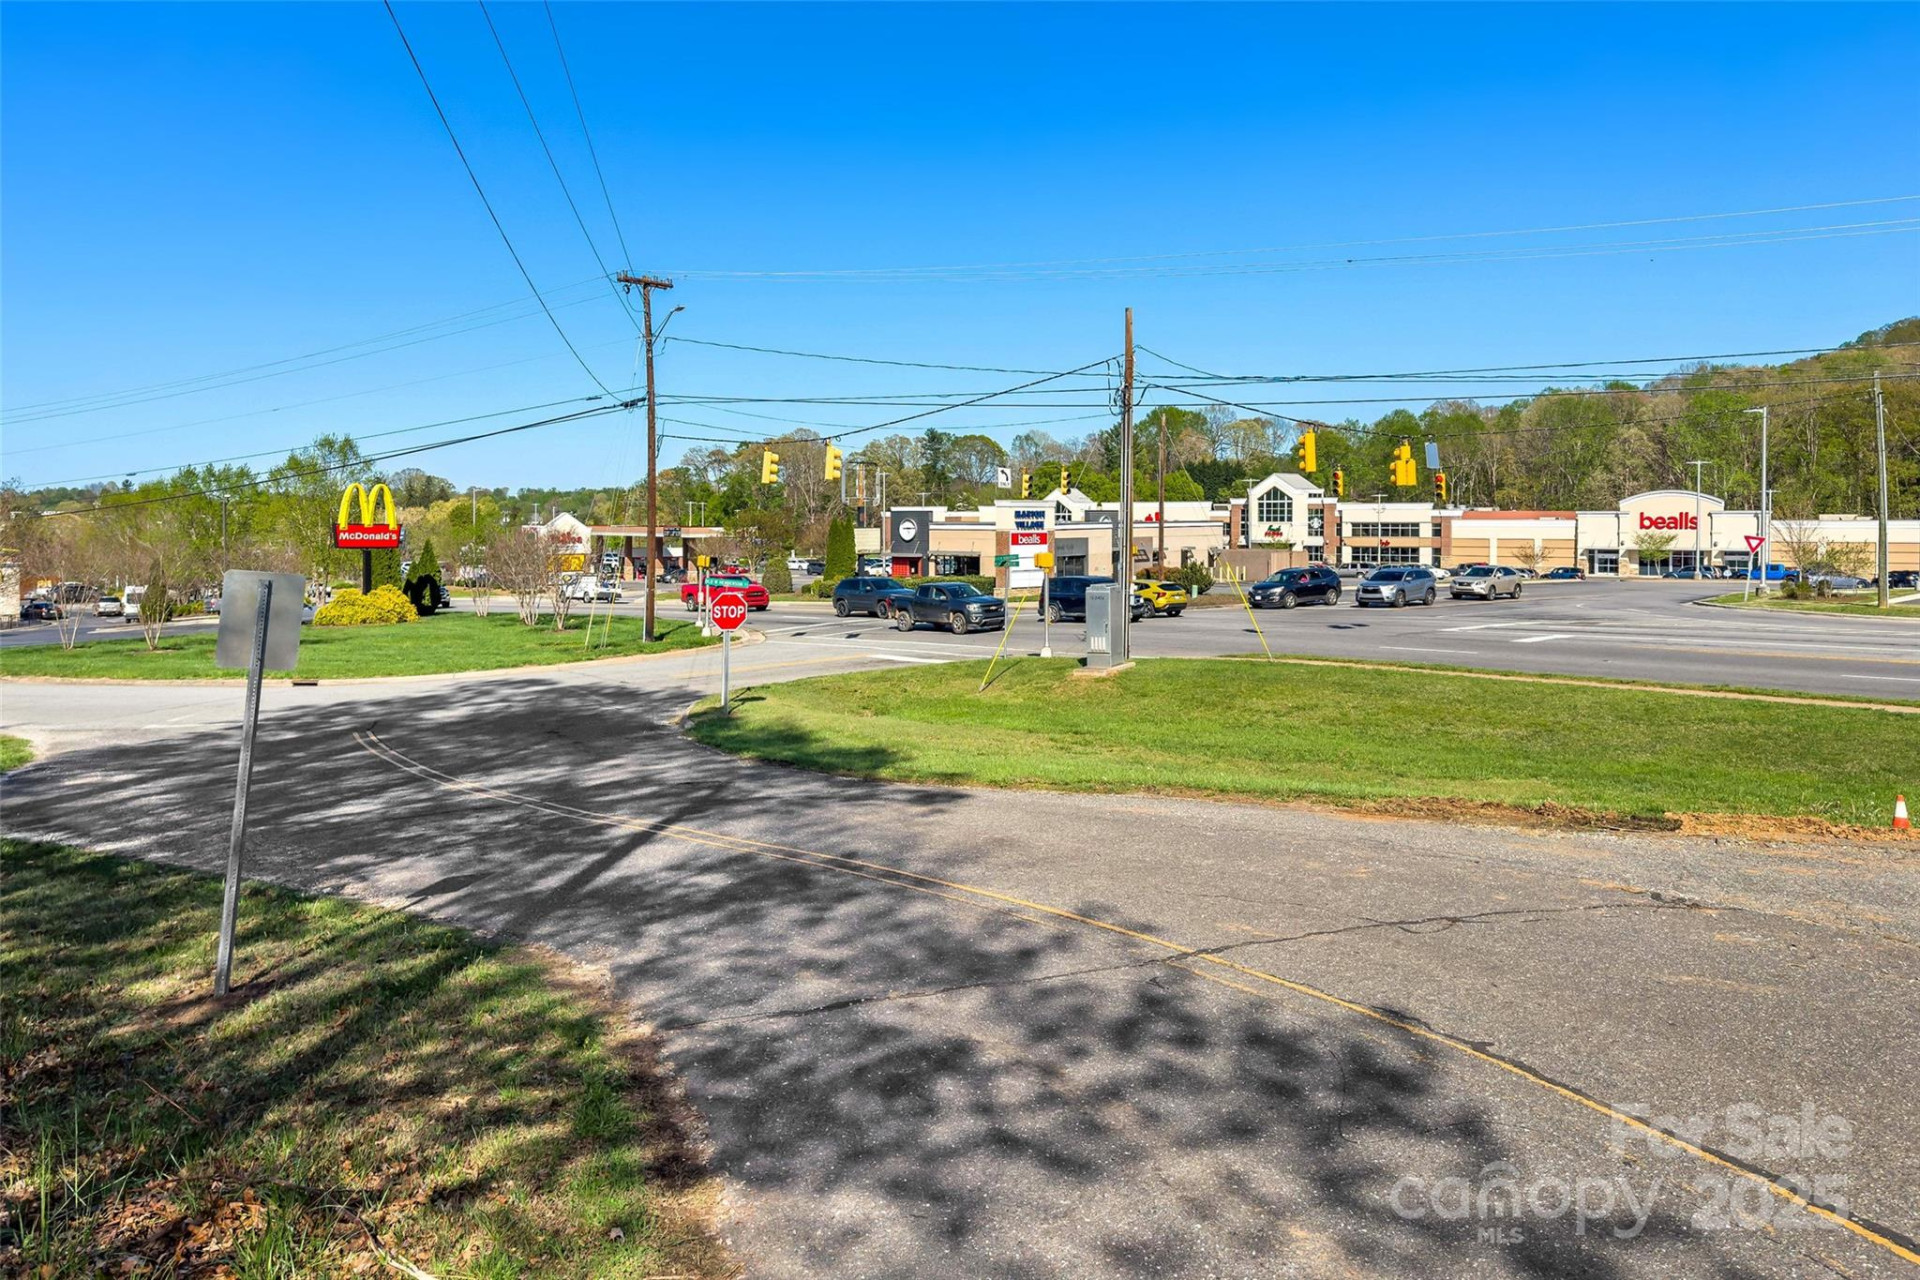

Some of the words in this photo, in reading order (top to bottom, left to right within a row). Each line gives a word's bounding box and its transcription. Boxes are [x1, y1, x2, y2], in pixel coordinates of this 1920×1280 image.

[1639, 511, 1698, 530] bealls
[339, 532, 397, 540] McDonald's
[1018, 534, 1041, 544] bealls
[713, 605, 745, 618] STOP
